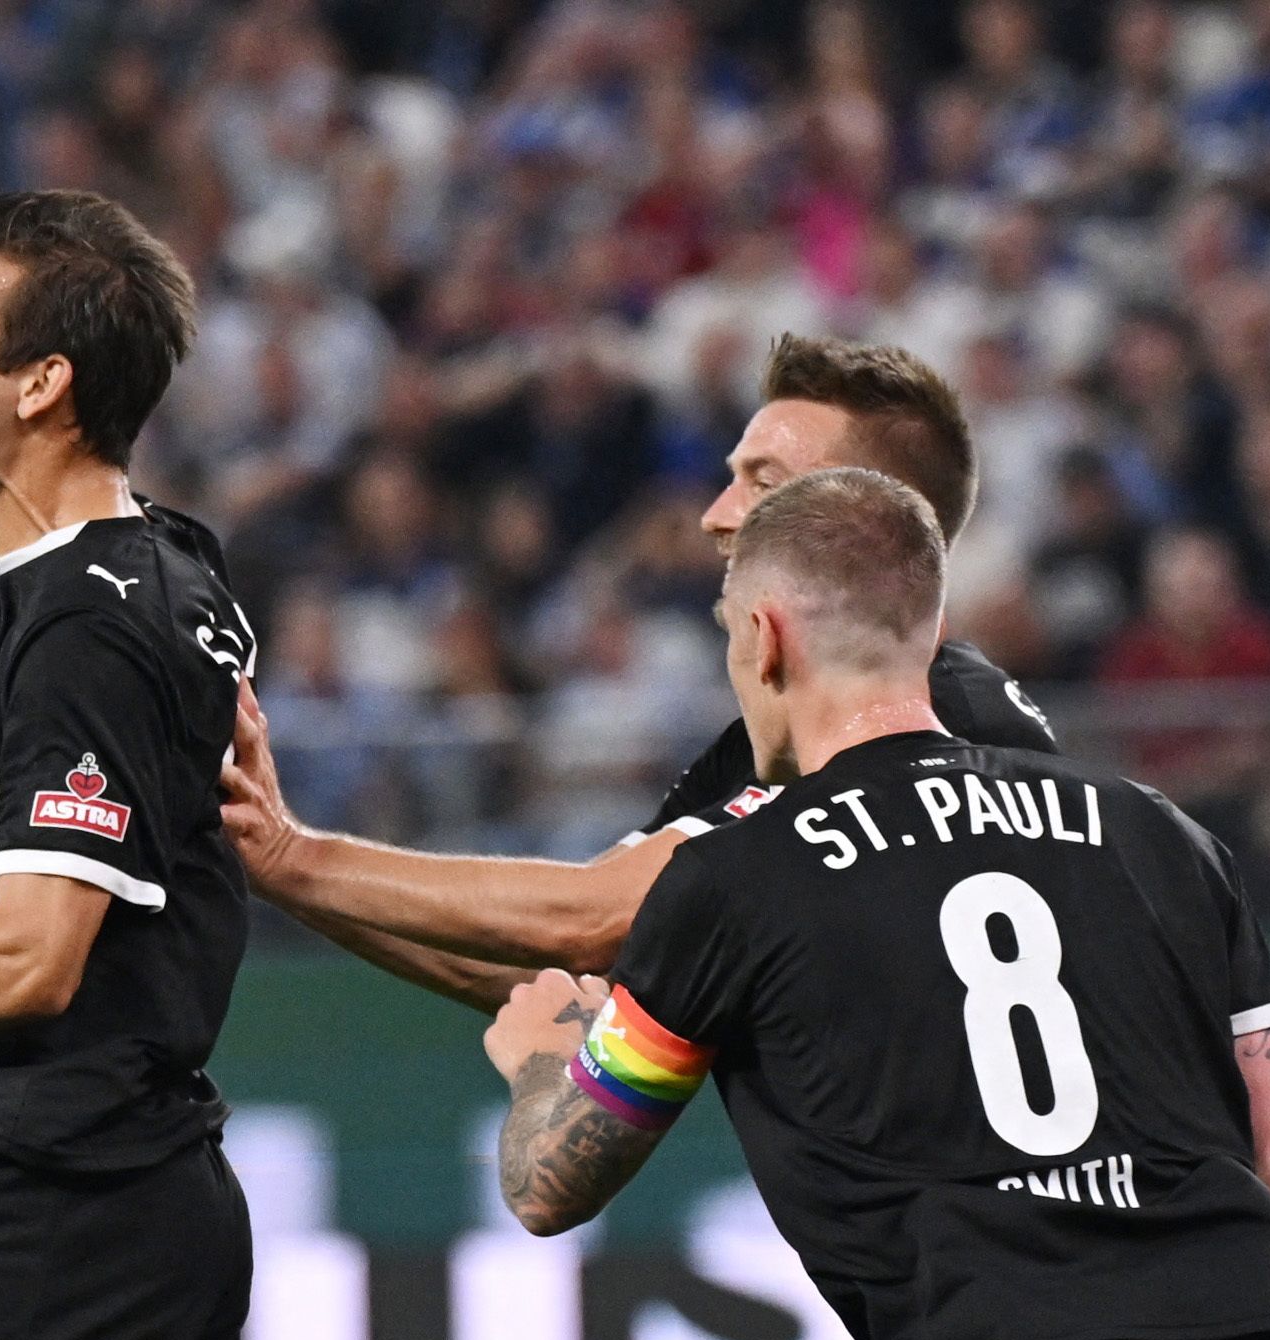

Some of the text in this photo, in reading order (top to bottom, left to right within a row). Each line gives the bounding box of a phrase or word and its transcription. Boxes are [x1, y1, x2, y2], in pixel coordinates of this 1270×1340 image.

[39, 800, 120, 831] ASTRA
[793, 773, 1102, 870] ST. PAULI
[939, 871, 1100, 1156] 8
[996, 1153, 1141, 1209] MITH
